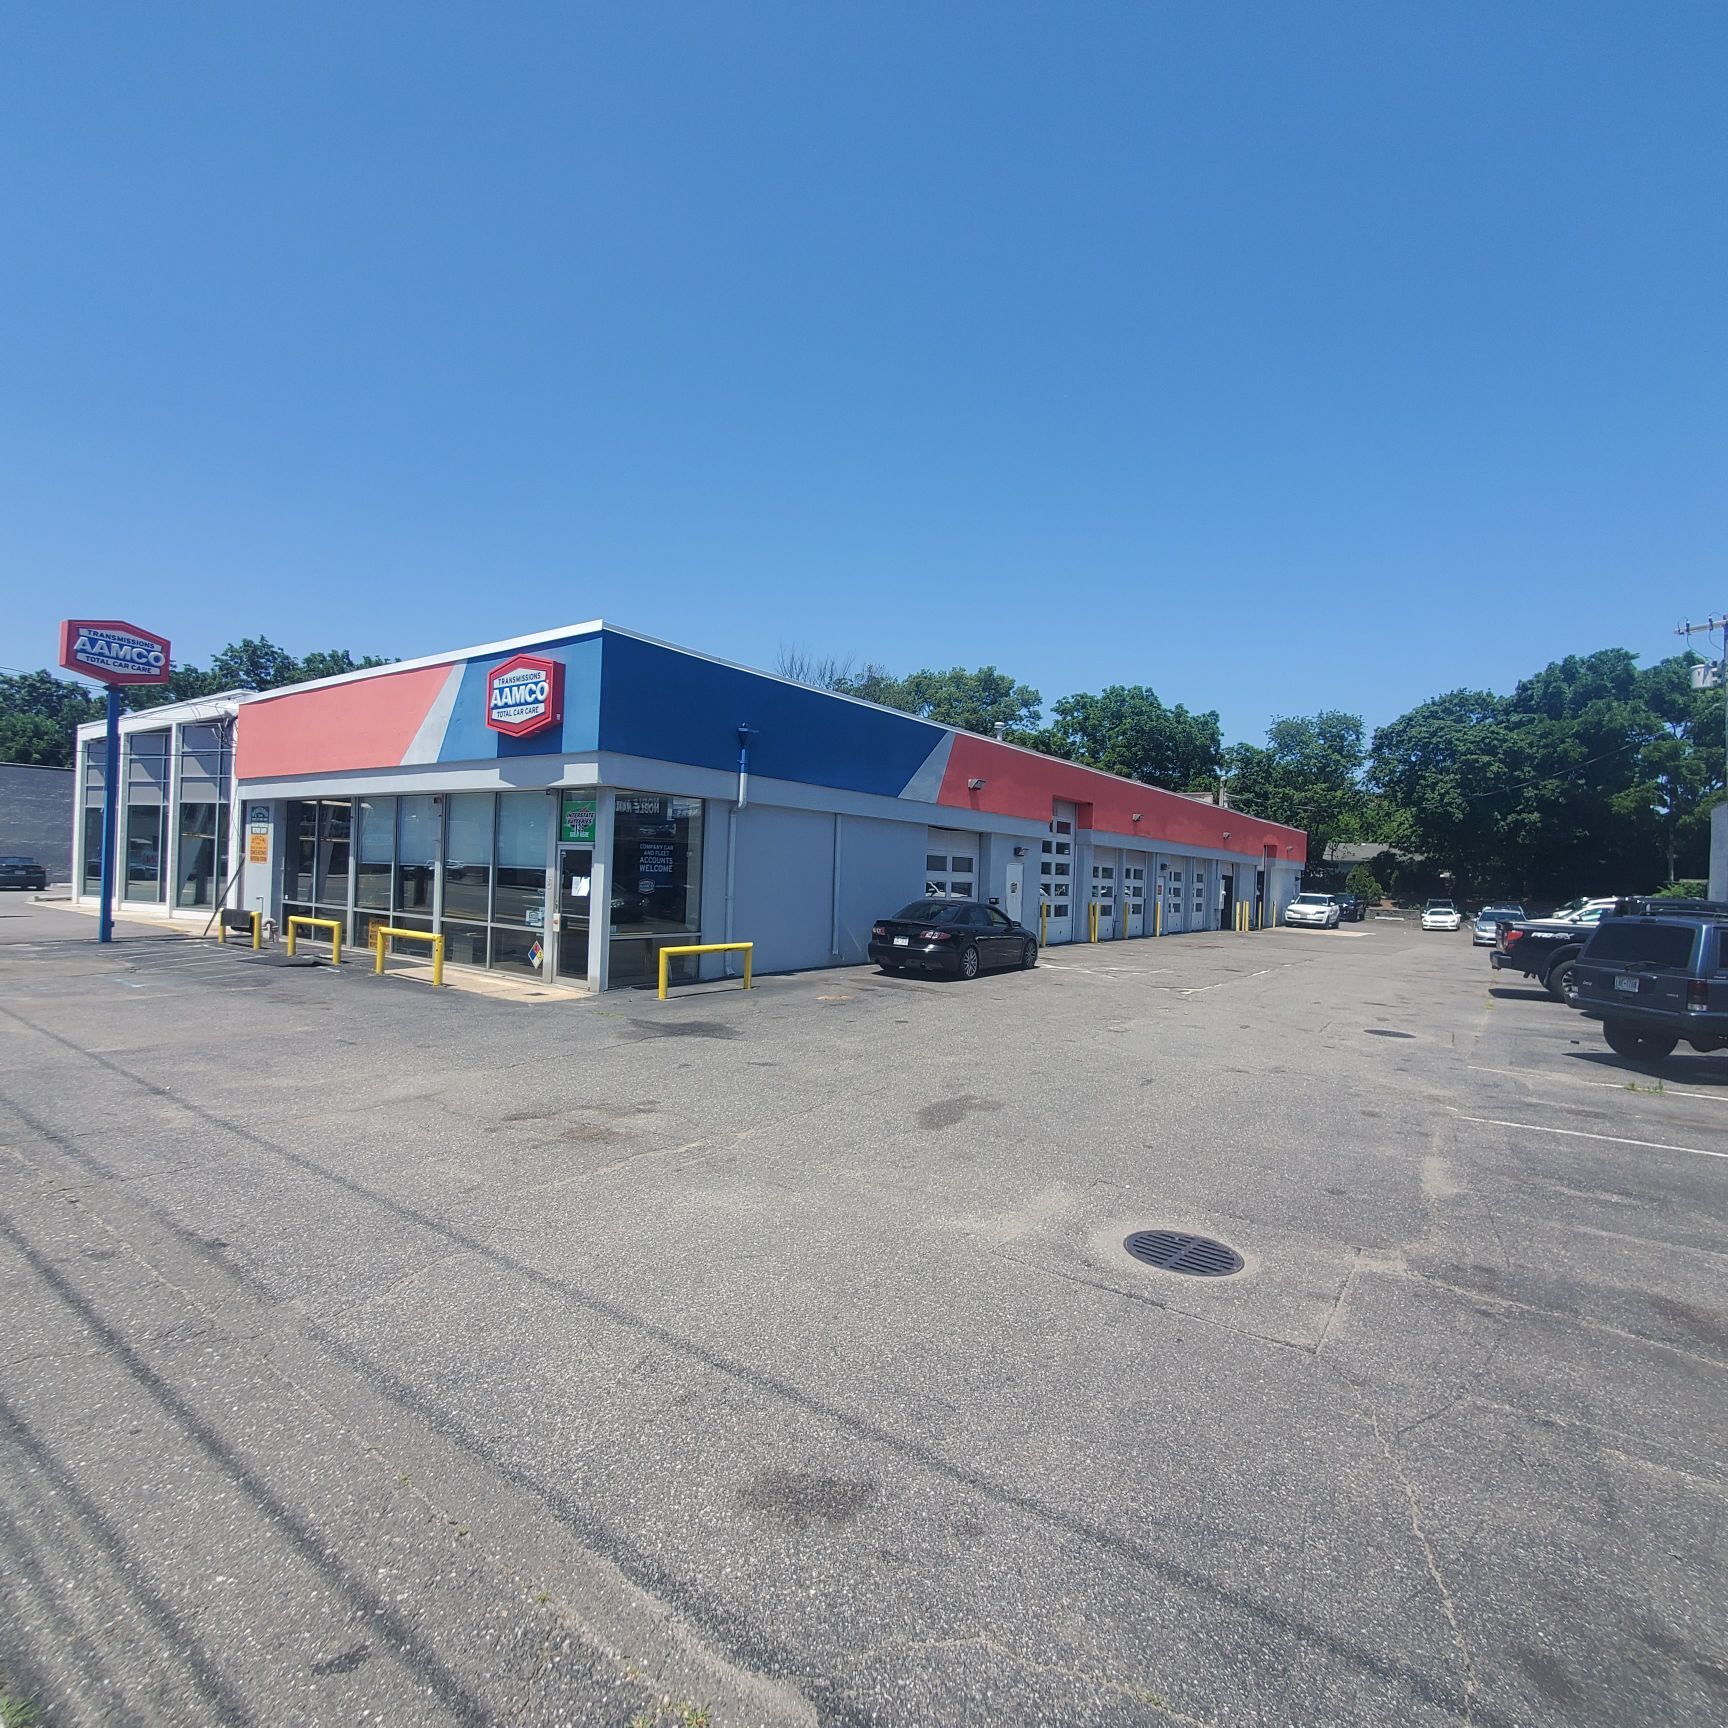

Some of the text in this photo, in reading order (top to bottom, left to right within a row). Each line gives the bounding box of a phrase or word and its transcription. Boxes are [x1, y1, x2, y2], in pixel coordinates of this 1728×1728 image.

[87, 629, 155, 649] TRANSMISSIONS
[73, 636, 165, 667] AAMCO
[86, 655, 152, 674] TOTAL CAR CARE
[498, 672, 541, 685] TRANSMISSIONS
[490, 681, 549, 707] AAMCO
[497, 706, 539, 718] TOTAL CAR CARE
[640, 856, 673, 864] ACCOUNTS
[640, 864, 673, 872] WELCOME
